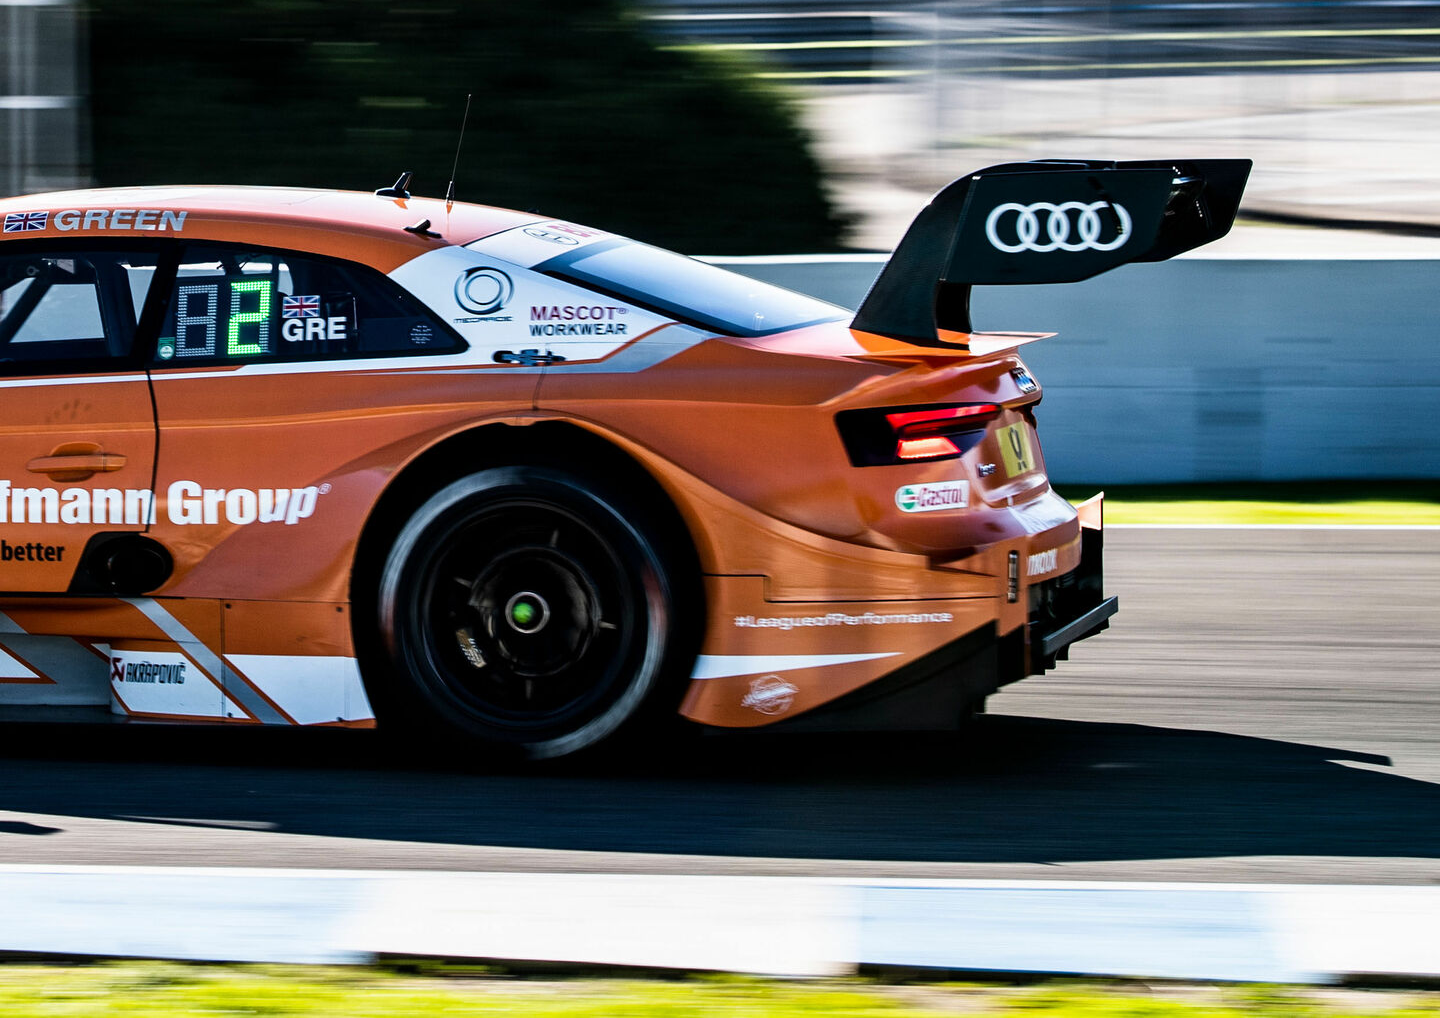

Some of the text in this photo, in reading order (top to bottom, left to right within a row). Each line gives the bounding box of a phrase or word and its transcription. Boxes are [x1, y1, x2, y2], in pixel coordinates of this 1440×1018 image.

[53, 209, 188, 232] GREEN
[282, 317, 347, 342] GRE
[528, 323, 628, 337] WORKWEAR
[1, 539, 65, 562] better
